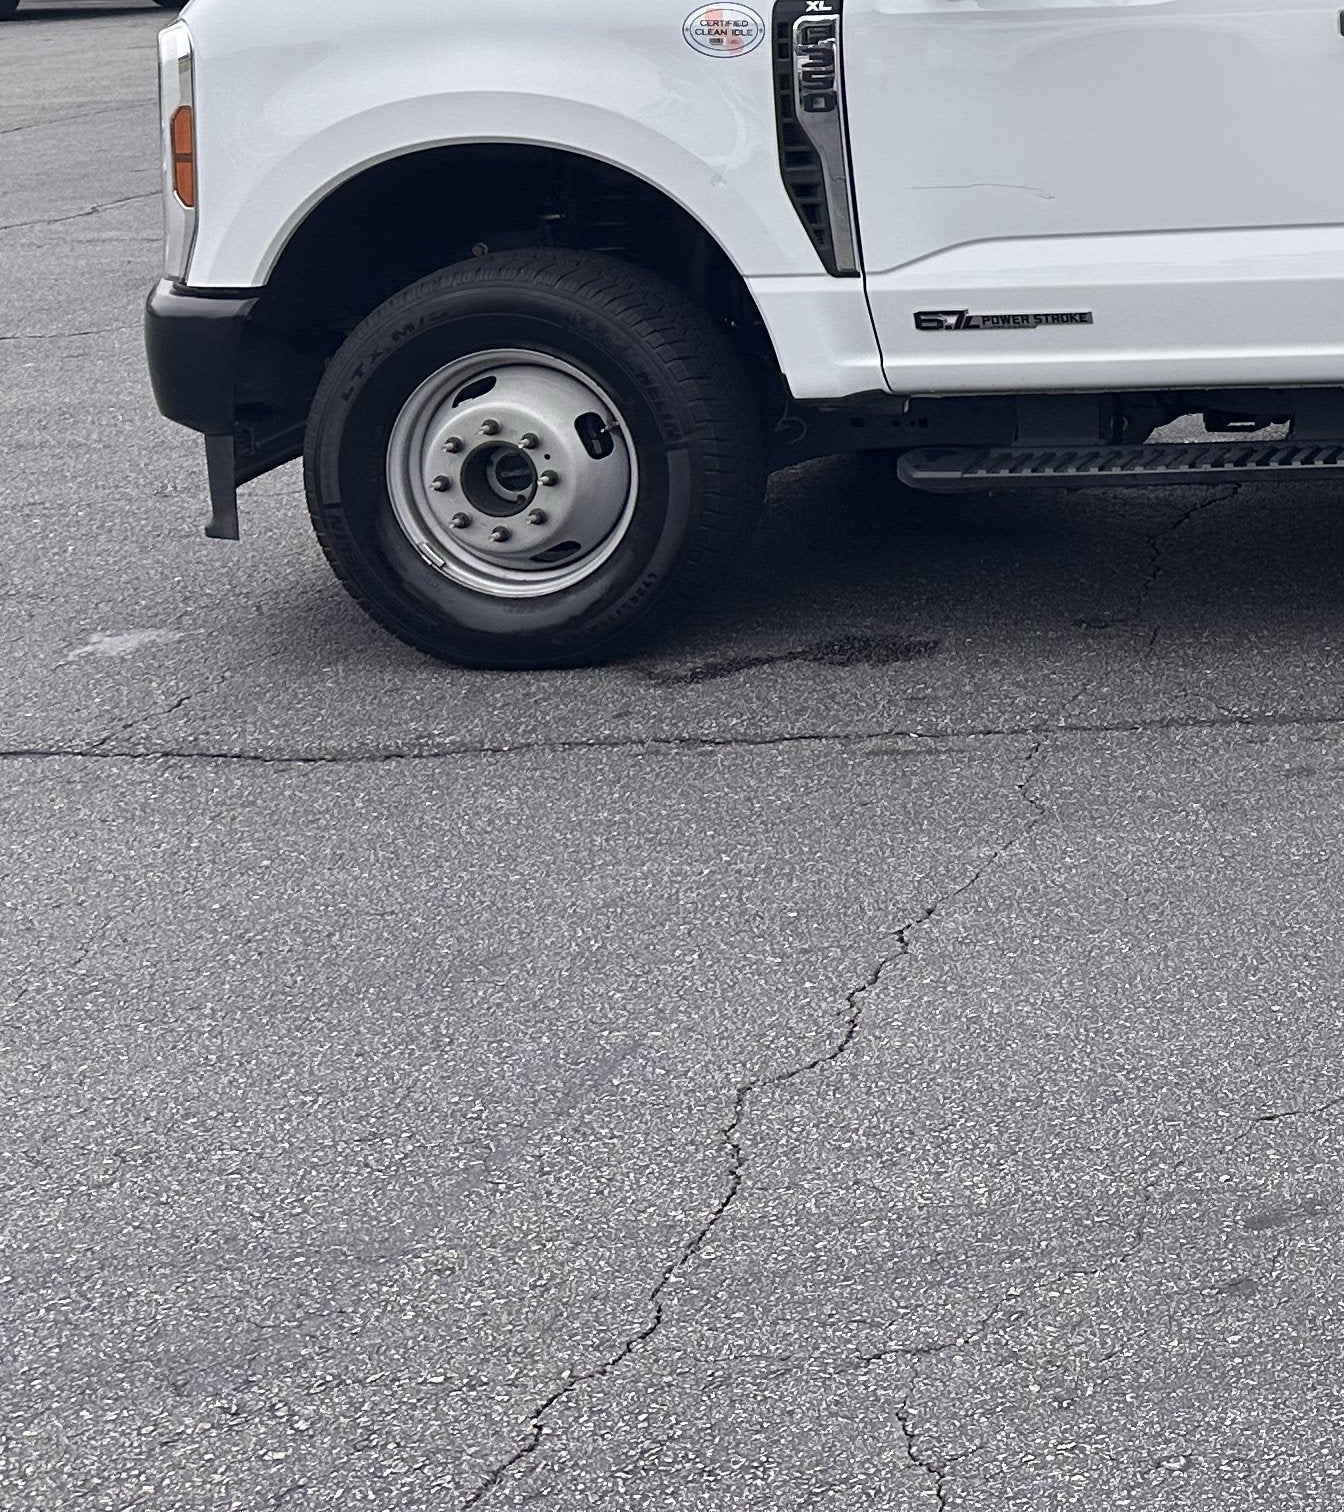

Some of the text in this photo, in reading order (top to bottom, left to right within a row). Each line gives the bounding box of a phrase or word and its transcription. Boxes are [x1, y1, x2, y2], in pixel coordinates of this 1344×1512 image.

[805, 0, 832, 12] XL
[699, 19, 748, 27] CERTIFIED
[694, 28, 754, 36] CLEAN IDLE
[982, 314, 1030, 326] POWER
[1033, 312, 1088, 325] STROKE
